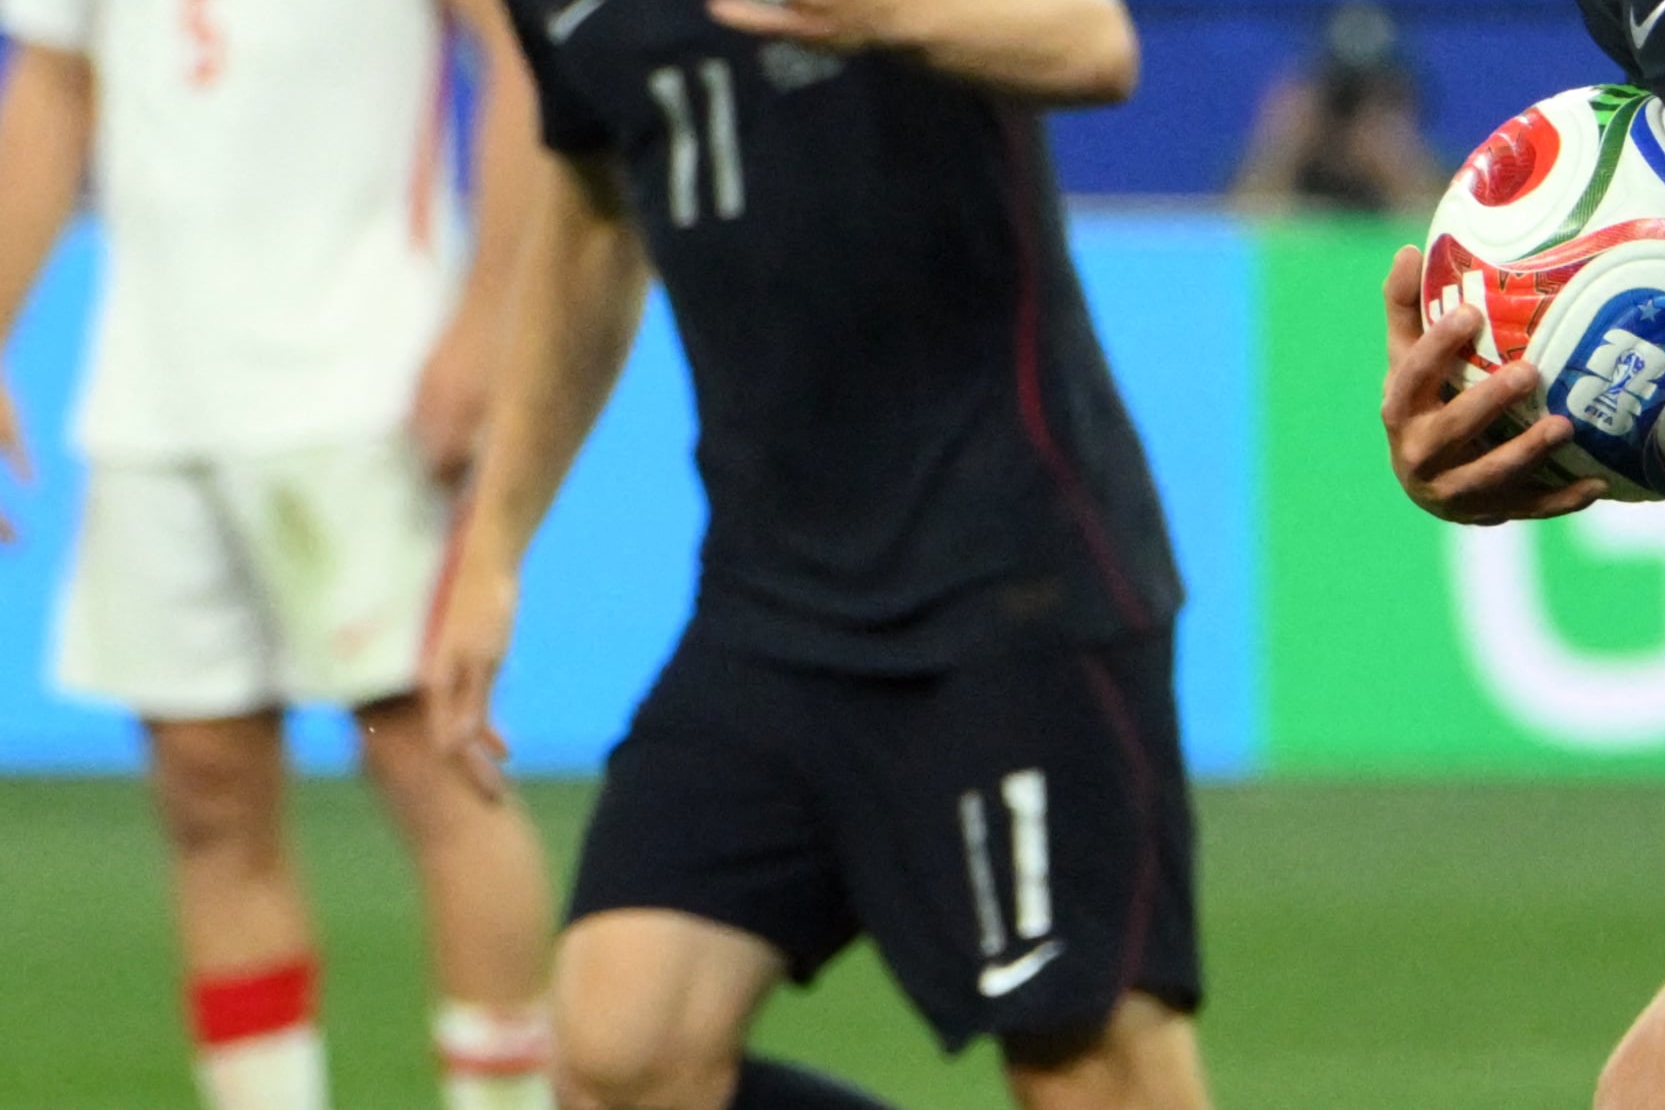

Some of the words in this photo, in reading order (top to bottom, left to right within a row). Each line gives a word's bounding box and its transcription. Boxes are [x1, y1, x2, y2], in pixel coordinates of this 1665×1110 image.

[648, 62, 746, 228] 11
[1584, 404, 1614, 427] FIFA
[958, 766, 1052, 957] 11
